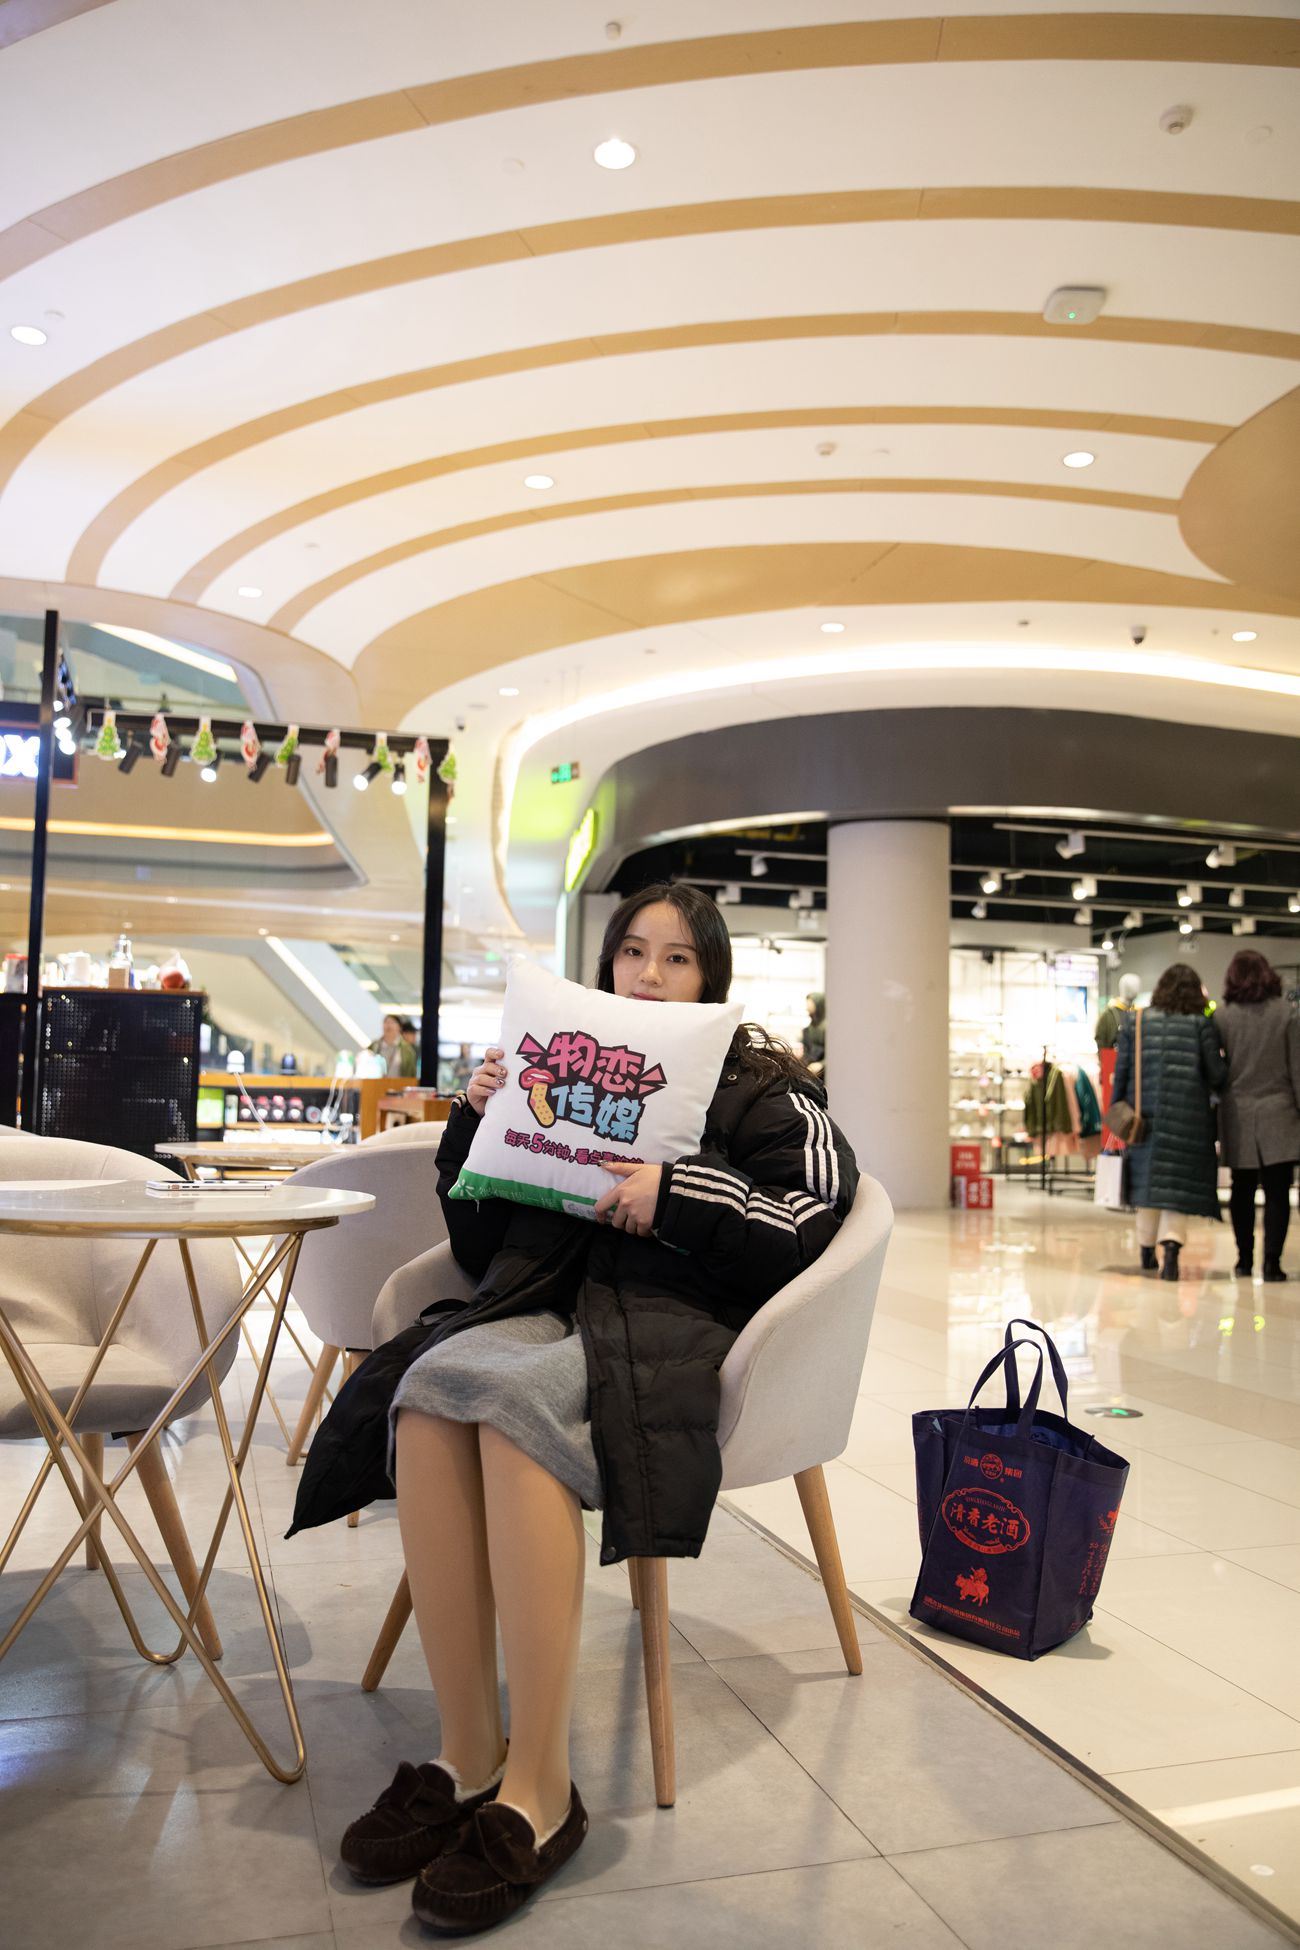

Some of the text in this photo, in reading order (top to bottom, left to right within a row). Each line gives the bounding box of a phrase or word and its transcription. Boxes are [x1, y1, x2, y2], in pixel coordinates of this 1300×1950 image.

[0, 735, 40, 777] X
[545, 1031, 646, 1094] 物恋
[550, 1081, 643, 1143] 传媒
[950, 1502, 1019, 1539] 清香老酒
